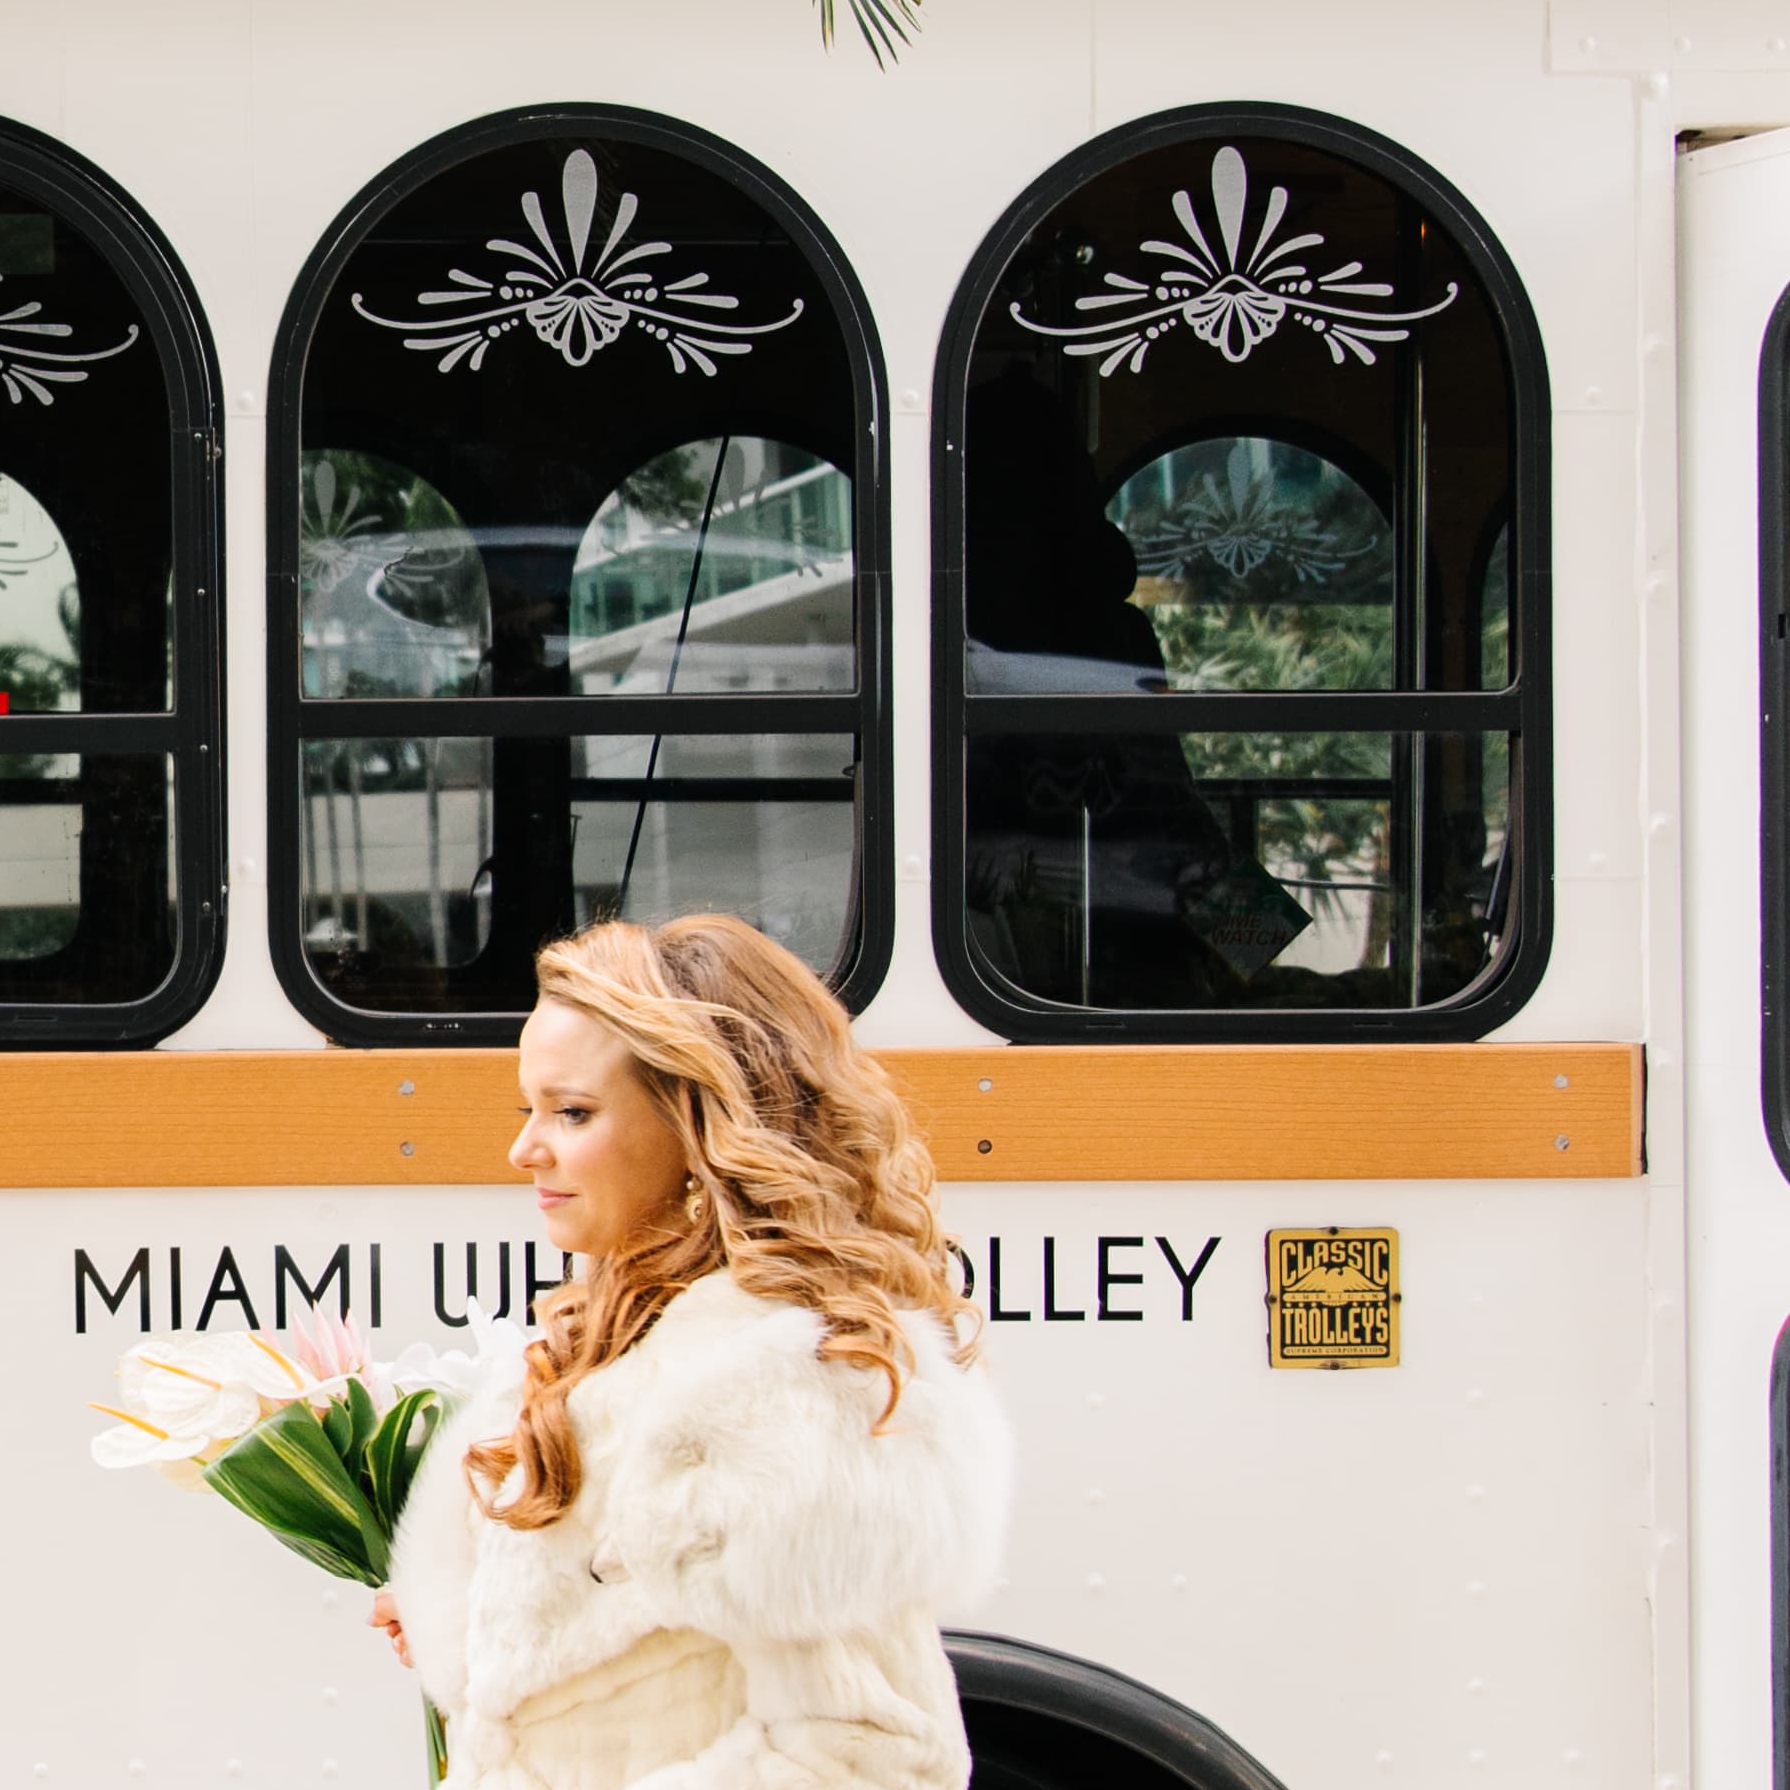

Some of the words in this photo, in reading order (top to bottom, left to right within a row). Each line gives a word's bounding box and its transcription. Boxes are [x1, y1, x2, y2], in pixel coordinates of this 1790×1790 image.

[1281, 1241, 1389, 1287] CLASSIC
[74, 1243, 381, 1334] MIAMI
[1282, 1307, 1389, 1345] TROLLEYS
